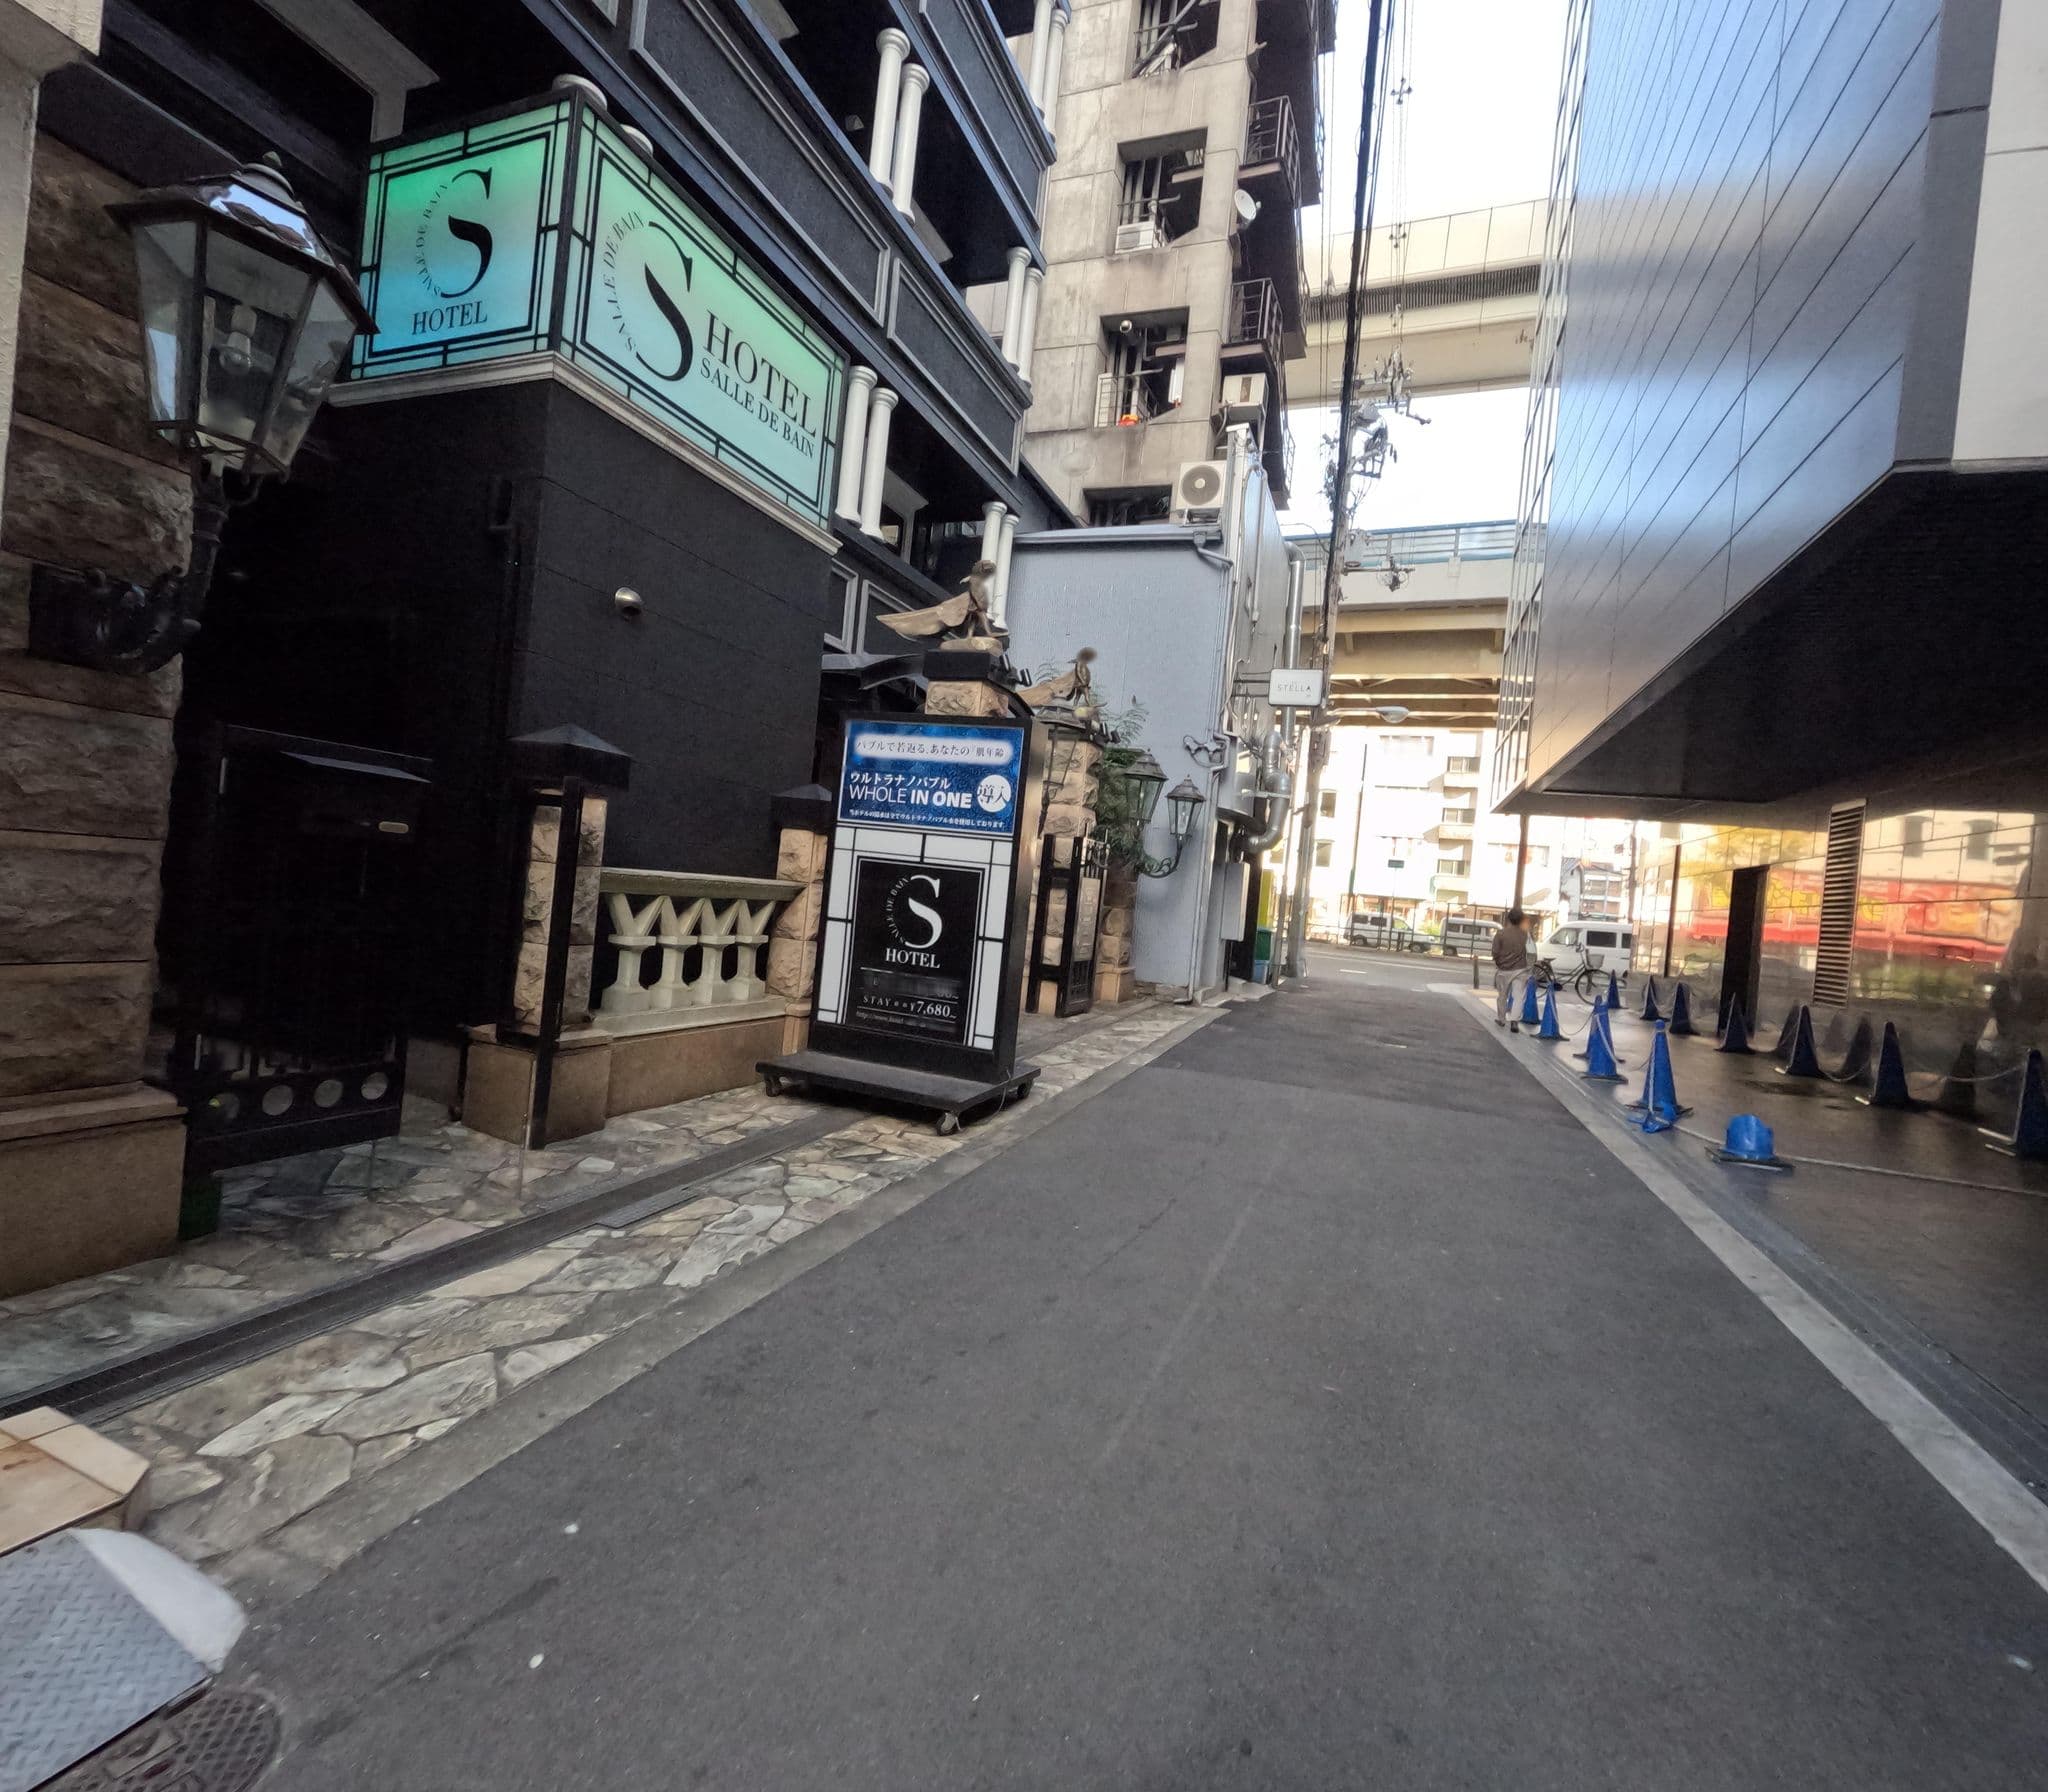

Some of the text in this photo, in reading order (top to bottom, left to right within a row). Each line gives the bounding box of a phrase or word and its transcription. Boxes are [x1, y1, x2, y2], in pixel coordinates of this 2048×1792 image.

[440, 167, 493, 298] S
[411, 300, 488, 336] HOTEL
[635, 220, 693, 382] S
[703, 309, 816, 438] HOTEL
[700, 357, 815, 459] SALLE DE BAIN
[849, 784, 973, 809] WHOLE IN ONE
[850, 772, 952, 789] ウルトラナノバブル
[978, 784, 1010, 804] 導入
[905, 874, 942, 948] S
[885, 948, 941, 969] HOTEL
[863, 995, 892, 1007] STAY
